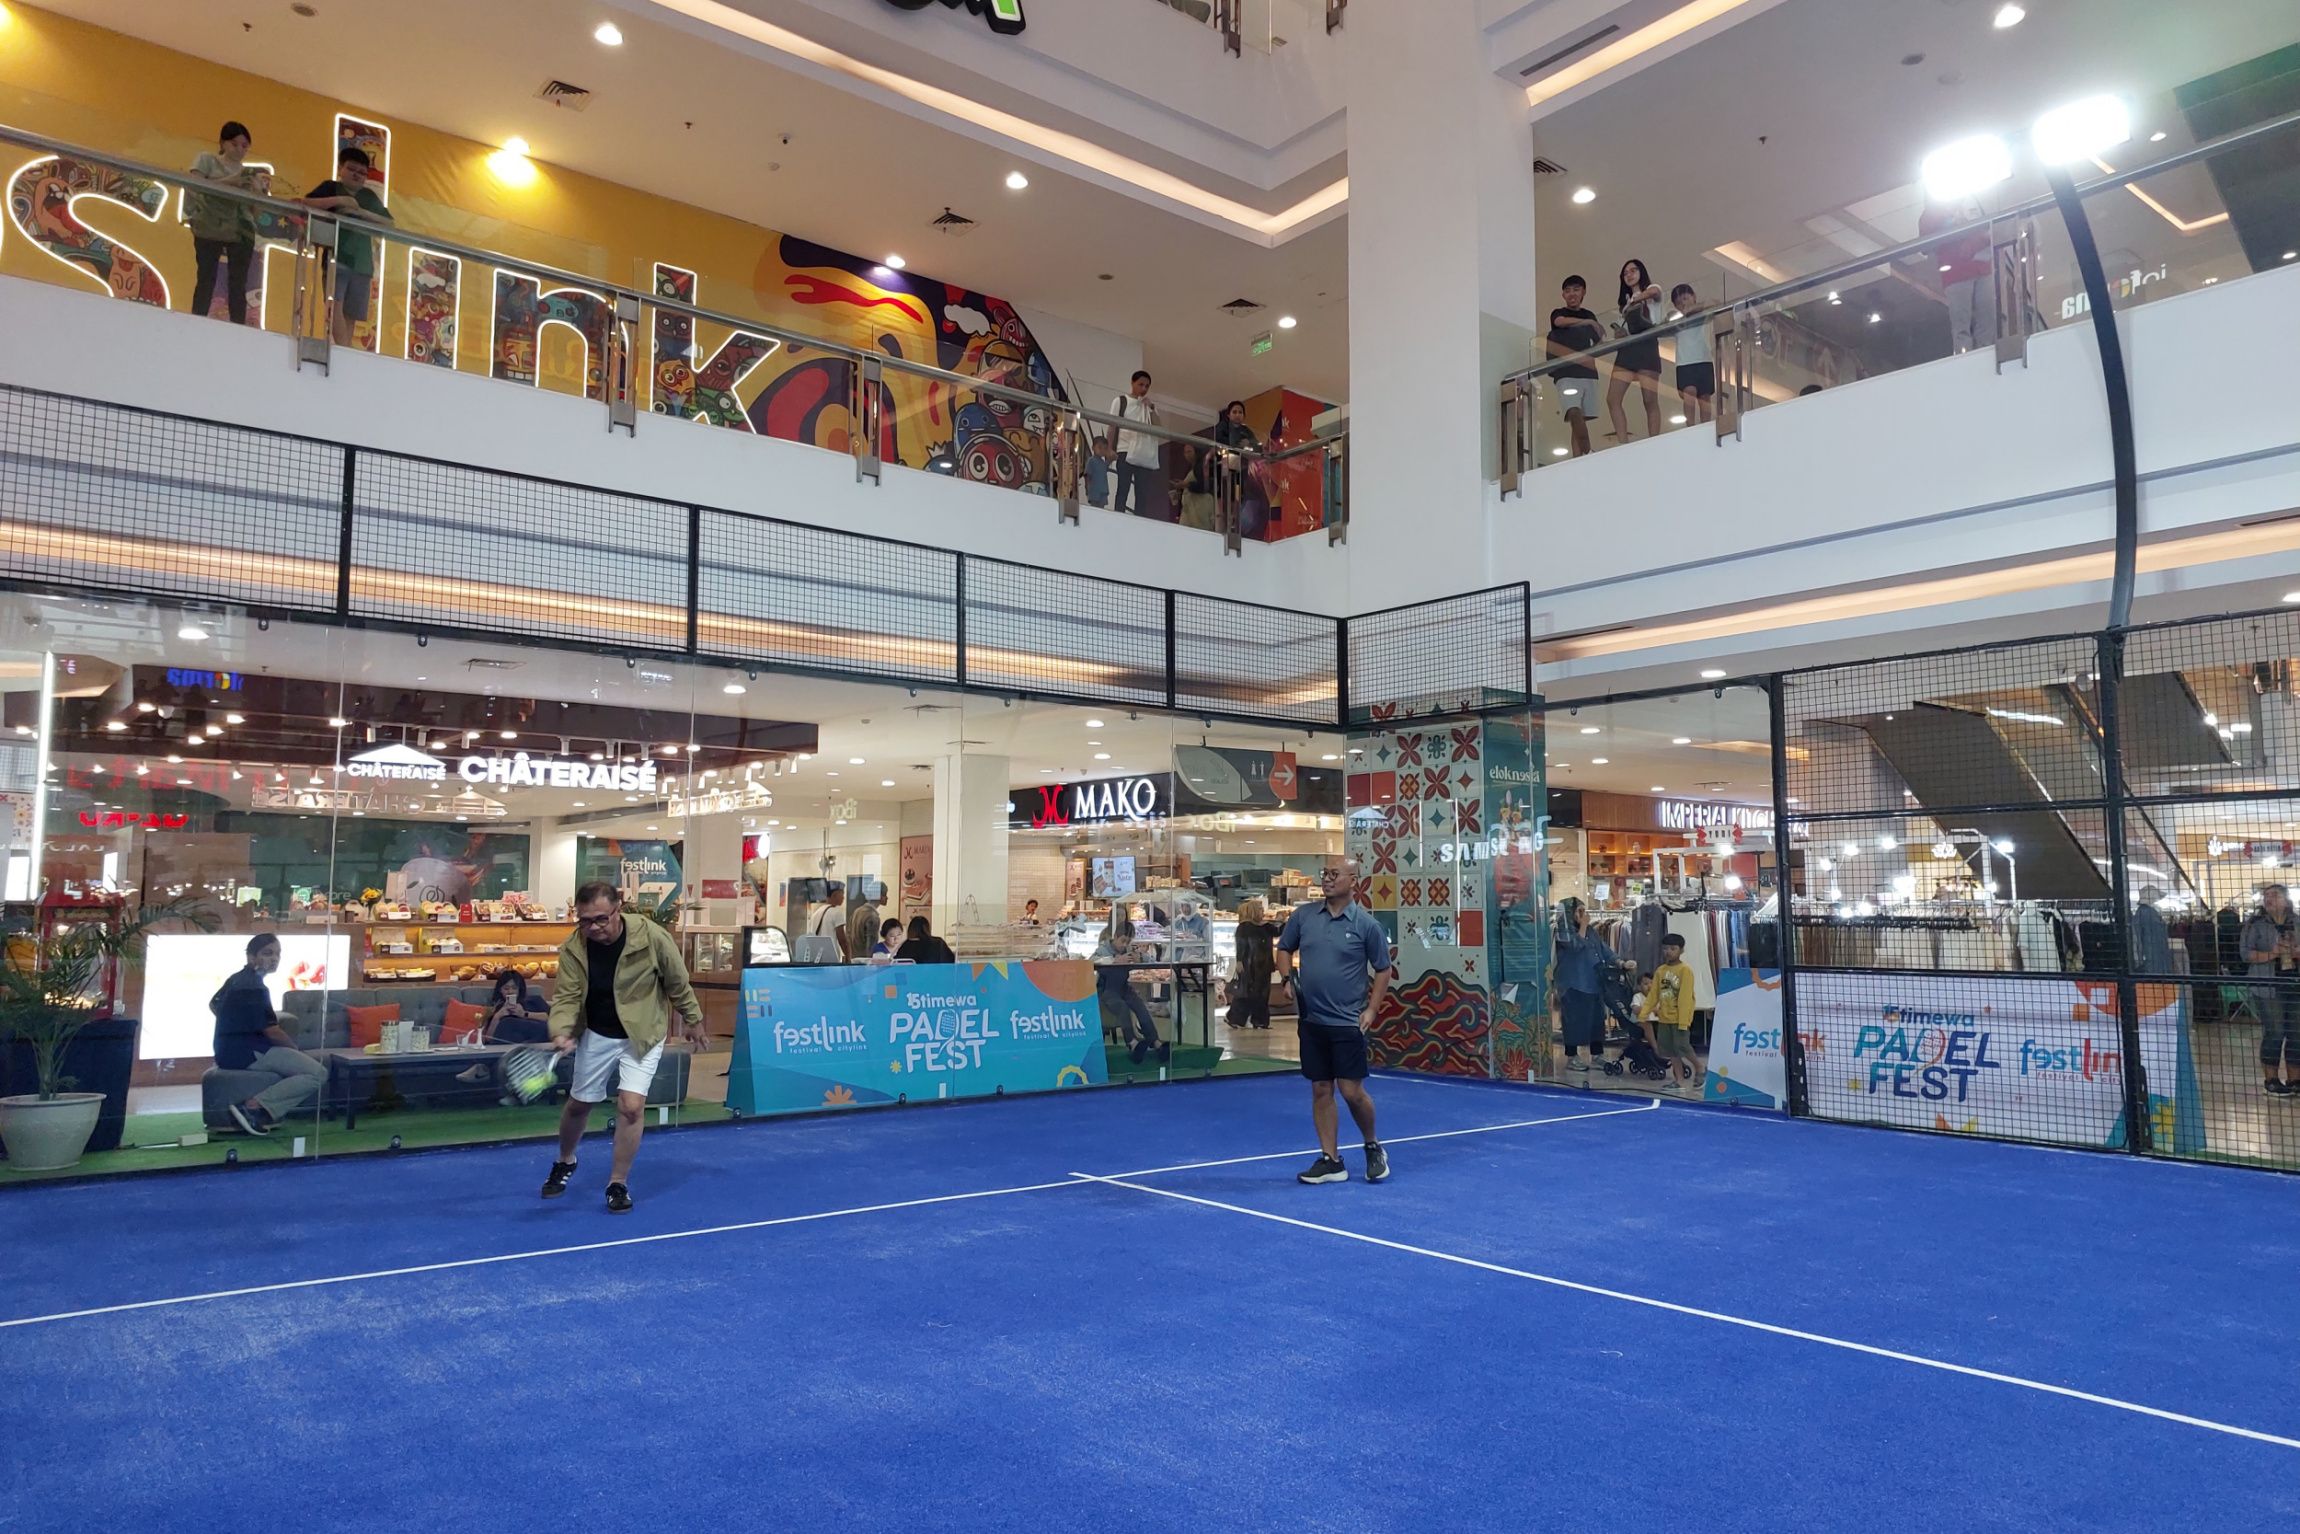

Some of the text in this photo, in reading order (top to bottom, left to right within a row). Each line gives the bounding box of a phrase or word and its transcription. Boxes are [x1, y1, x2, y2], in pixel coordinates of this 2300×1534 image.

[459, 752, 657, 792] CHÂTERAISÉ
[1075, 778, 1157, 822] MAKO
[1661, 800, 1809, 837] IMPERIAL KITCHN
[620, 857, 667, 875] festlink
[773, 1015, 867, 1054] festlink
[889, 1008, 1000, 1044] PADEL
[1010, 1005, 1086, 1040] festlink
[1733, 1022, 1826, 1057] festnk
[905, 1039, 987, 1074] FEST
[1853, 1025, 2000, 1068] PADEL
[2020, 1037, 2121, 1082] festlin
[1868, 1061, 1979, 1102] FEST
